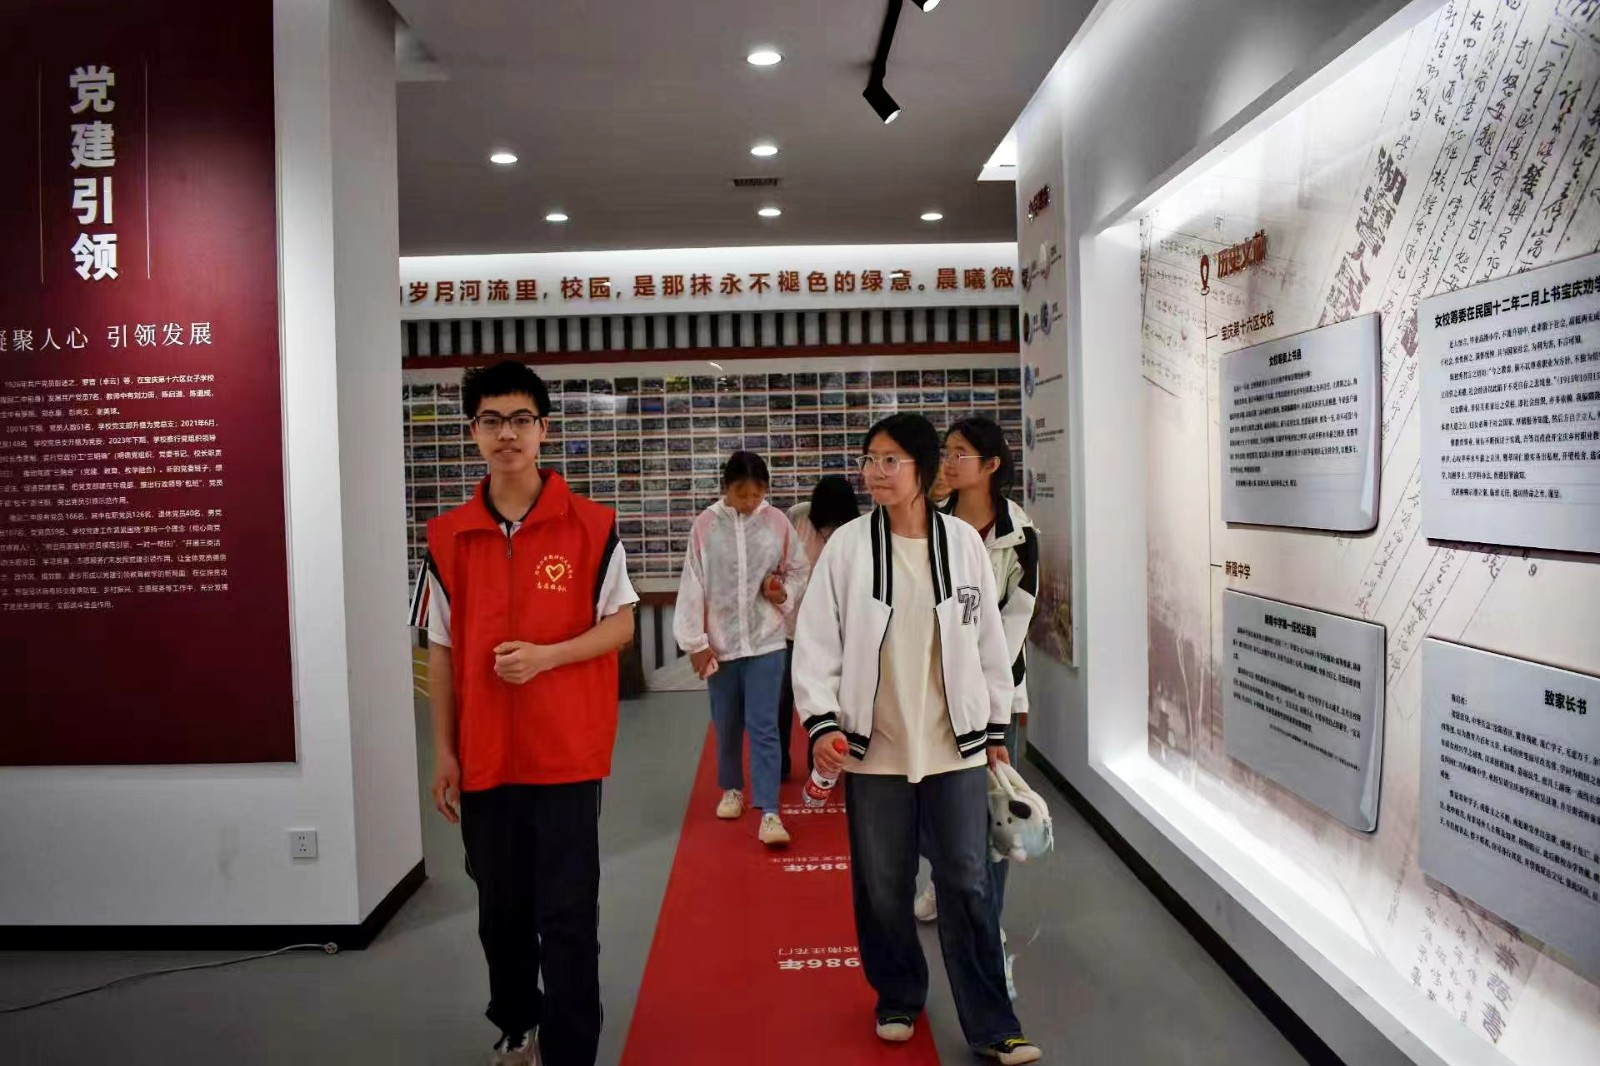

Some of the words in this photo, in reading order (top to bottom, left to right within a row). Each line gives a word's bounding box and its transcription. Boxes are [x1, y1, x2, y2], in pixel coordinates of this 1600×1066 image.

[69, 65, 119, 281] 党建引领
[1217, 229, 1266, 278] 历史文献
[400, 266, 1015, 303] 岁月河流里,校园,是那抹永不褪色的绿意。晨曦微
[107, 322, 213, 348] 引领发展
[1222, 310, 1275, 341] 宝庆第十六区女校
[1544, 689, 1587, 715] 致家长书
[784, 862, 848, 872] 984年
[777, 957, 861, 970] 986年
